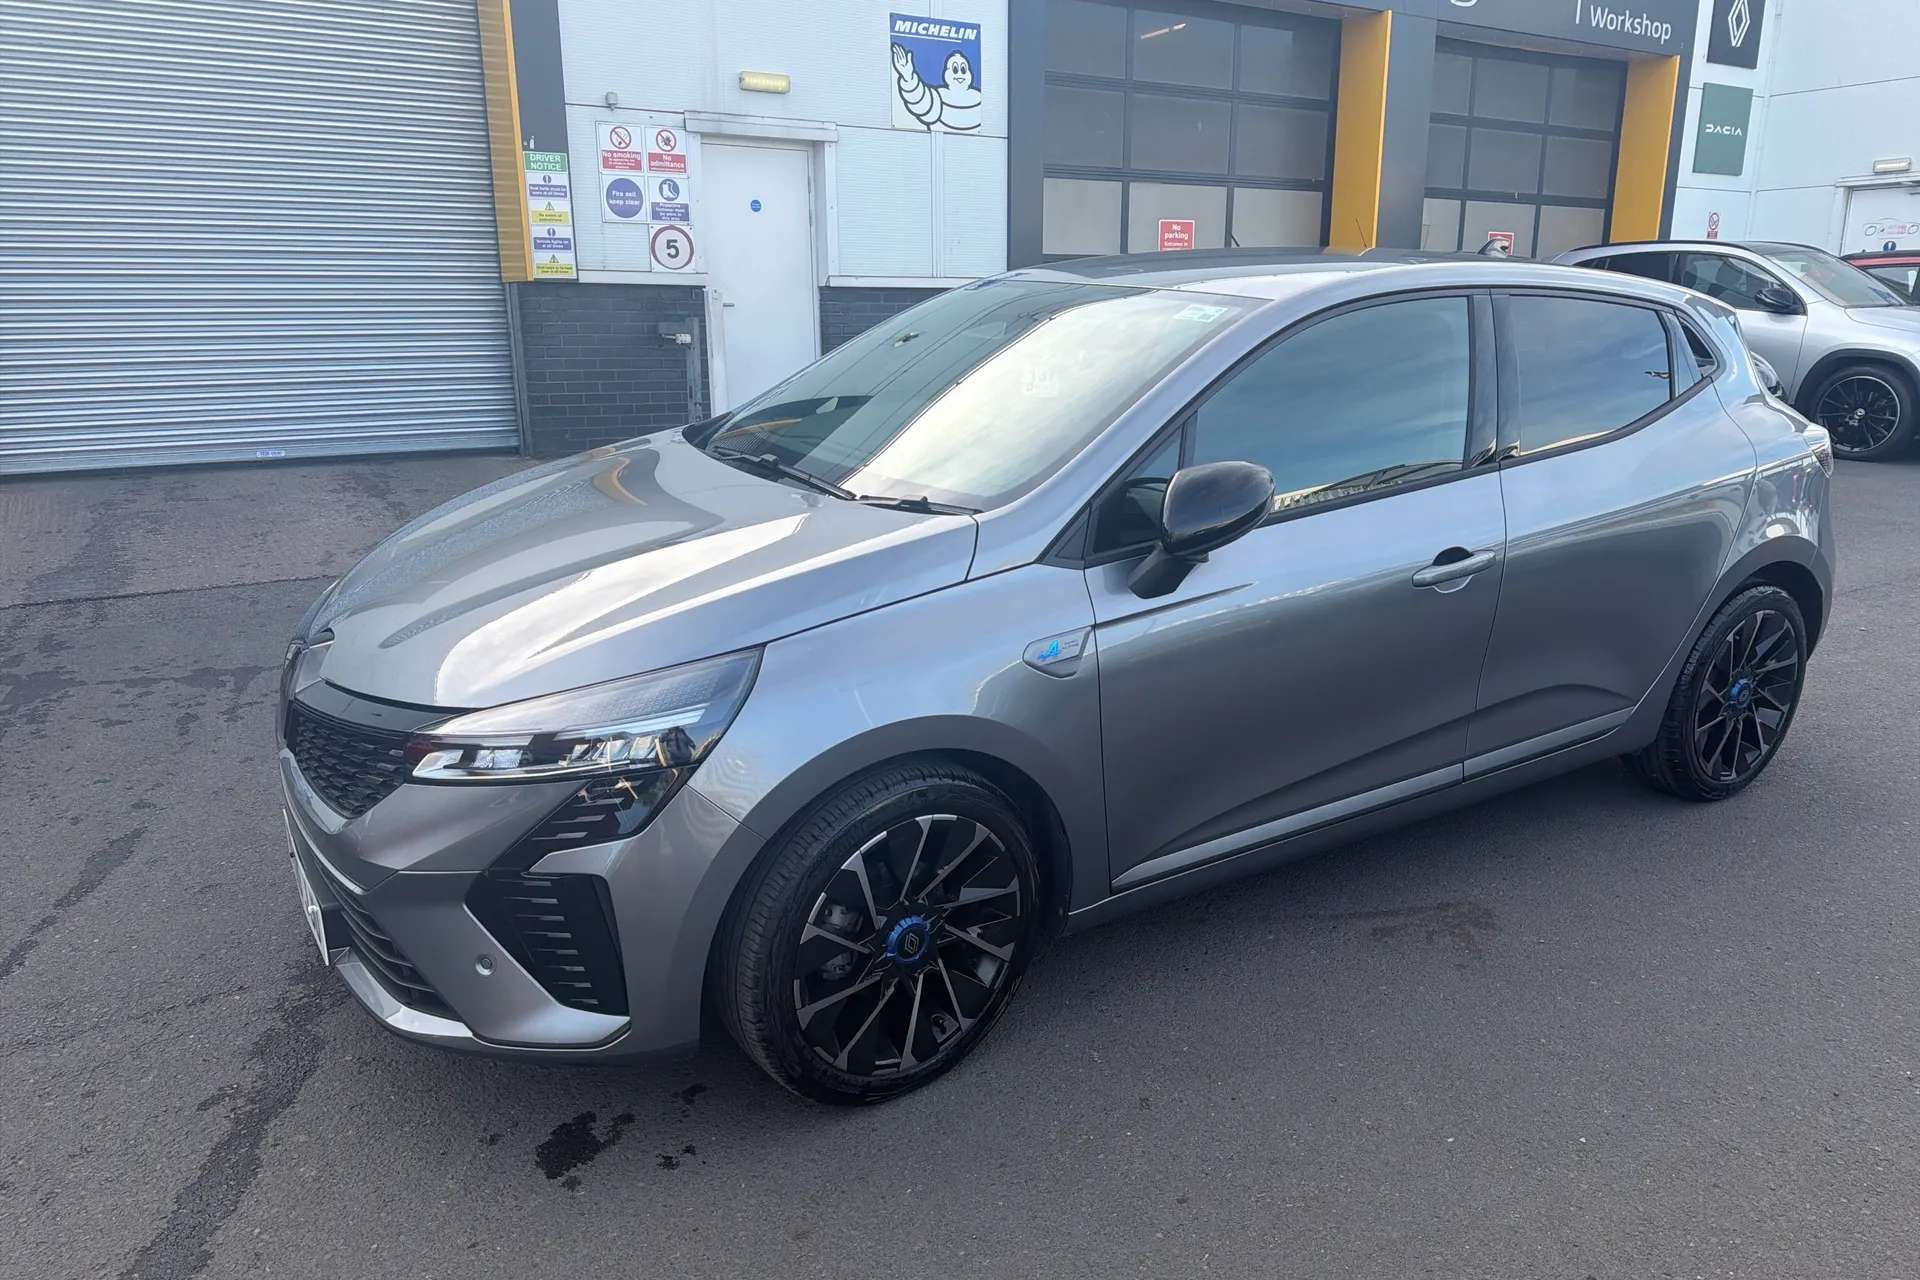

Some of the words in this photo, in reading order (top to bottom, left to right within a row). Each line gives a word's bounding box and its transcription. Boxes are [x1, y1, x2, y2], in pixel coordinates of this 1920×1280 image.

[1590, 5, 1671, 44] Workshop
[894, 20, 977, 40] MICHELIN
[1705, 123, 1742, 136] DACIA
[530, 153, 561, 162] DRIVER
[612, 152, 640, 160] smoking
[530, 161, 562, 171] NOTICE
[650, 160, 684, 168] admittance
[1164, 231, 1189, 240] parking
[666, 239, 680, 259] 5
